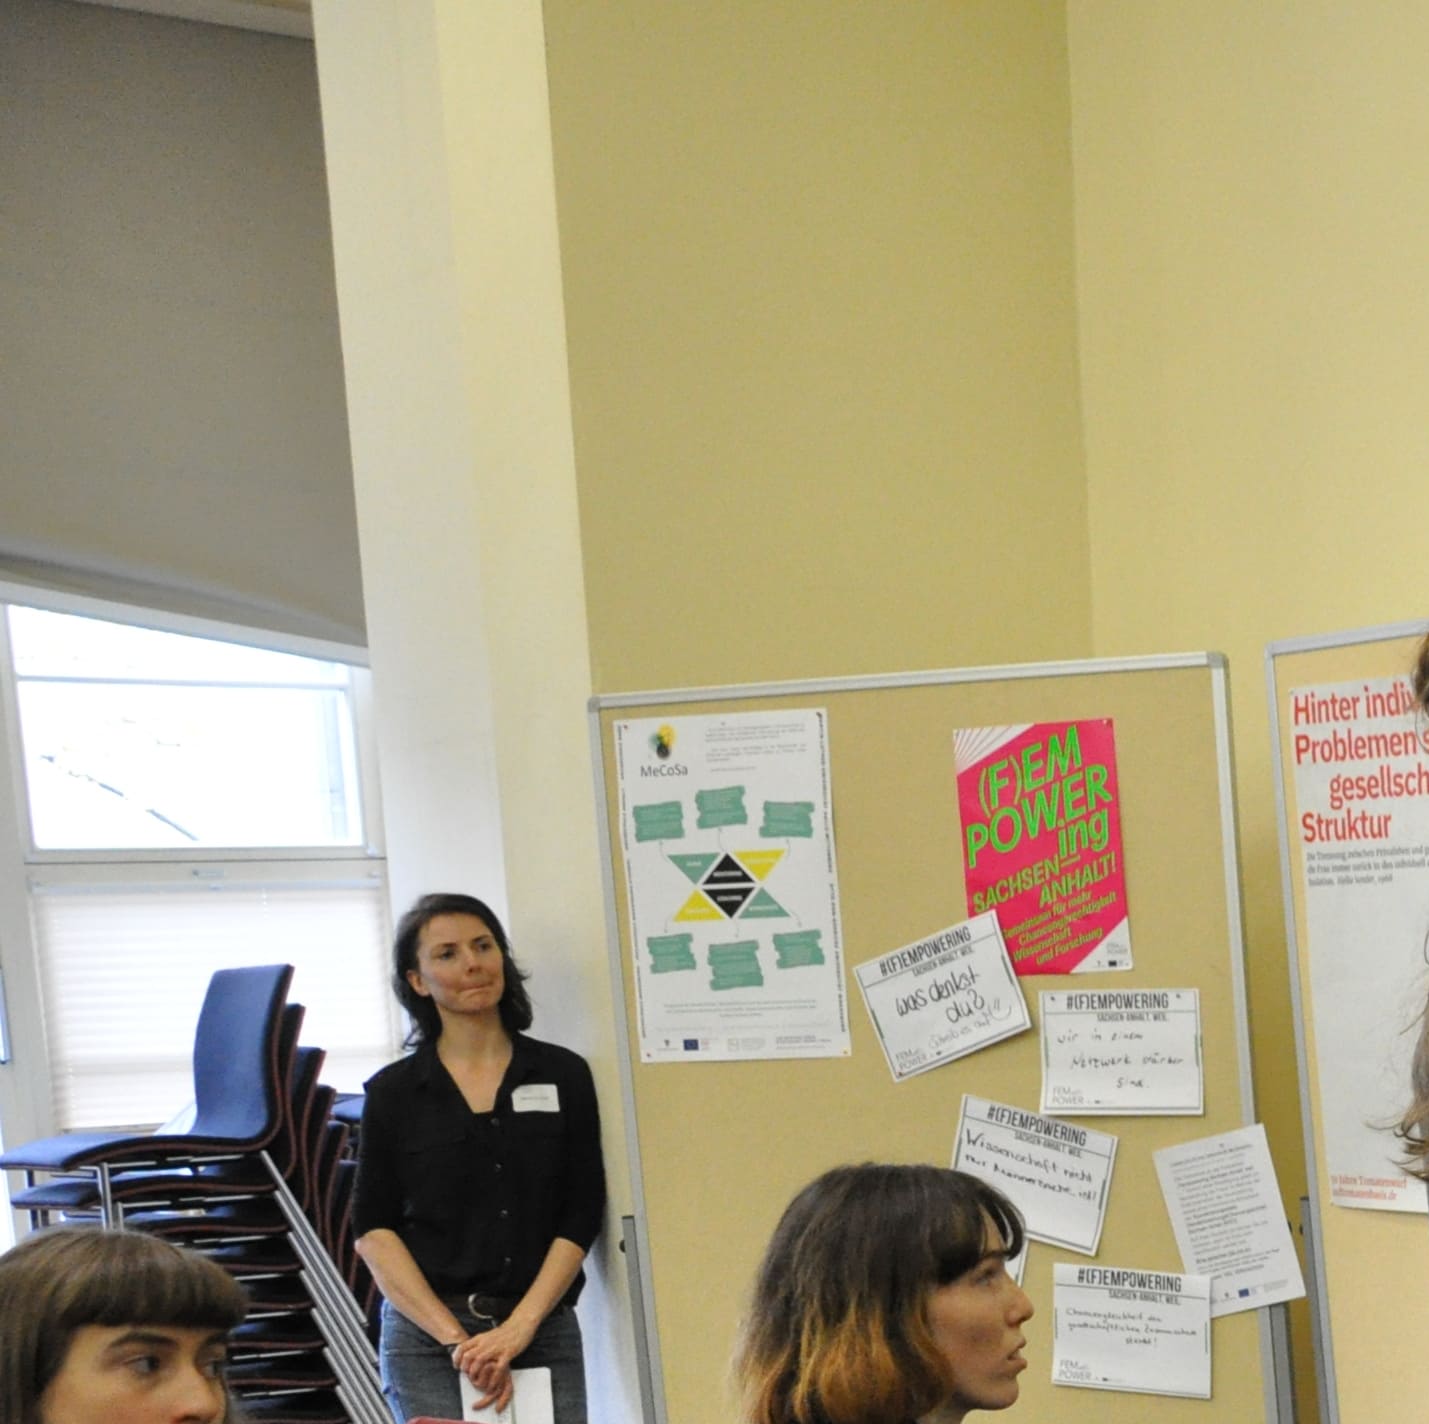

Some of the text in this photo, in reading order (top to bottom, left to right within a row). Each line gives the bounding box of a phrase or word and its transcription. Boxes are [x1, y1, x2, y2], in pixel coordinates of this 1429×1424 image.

[1294, 691, 1360, 726] Hinter
[1295, 728, 1416, 765] Problemen
[640, 764, 689, 777] MeCoSa
[978, 725, 1082, 818] (F)EM
[966, 764, 1113, 869] POWER
[1058, 808, 1109, 858] ing
[1301, 809, 1392, 842] Struktur
[1039, 851, 1116, 908] ANHALT!
[1053, 902, 1066, 916] für
[1069, 891, 1092, 907] mehr
[1014, 926, 1071, 963] Wissenschaft
[1037, 948, 1055, 967] und
[1054, 927, 1103, 956] Forschung
[895, 964, 981, 1018] was denkst
[945, 988, 985, 1024] du?
[1066, 993, 1169, 1010] #(F)EMPOWERING
[987, 1104, 1087, 1147] #(F)EMPOWERING
[966, 1128, 1057, 1174] Wissenschaft
[1077, 1268, 1182, 1292] #(F)EMPOWERING
